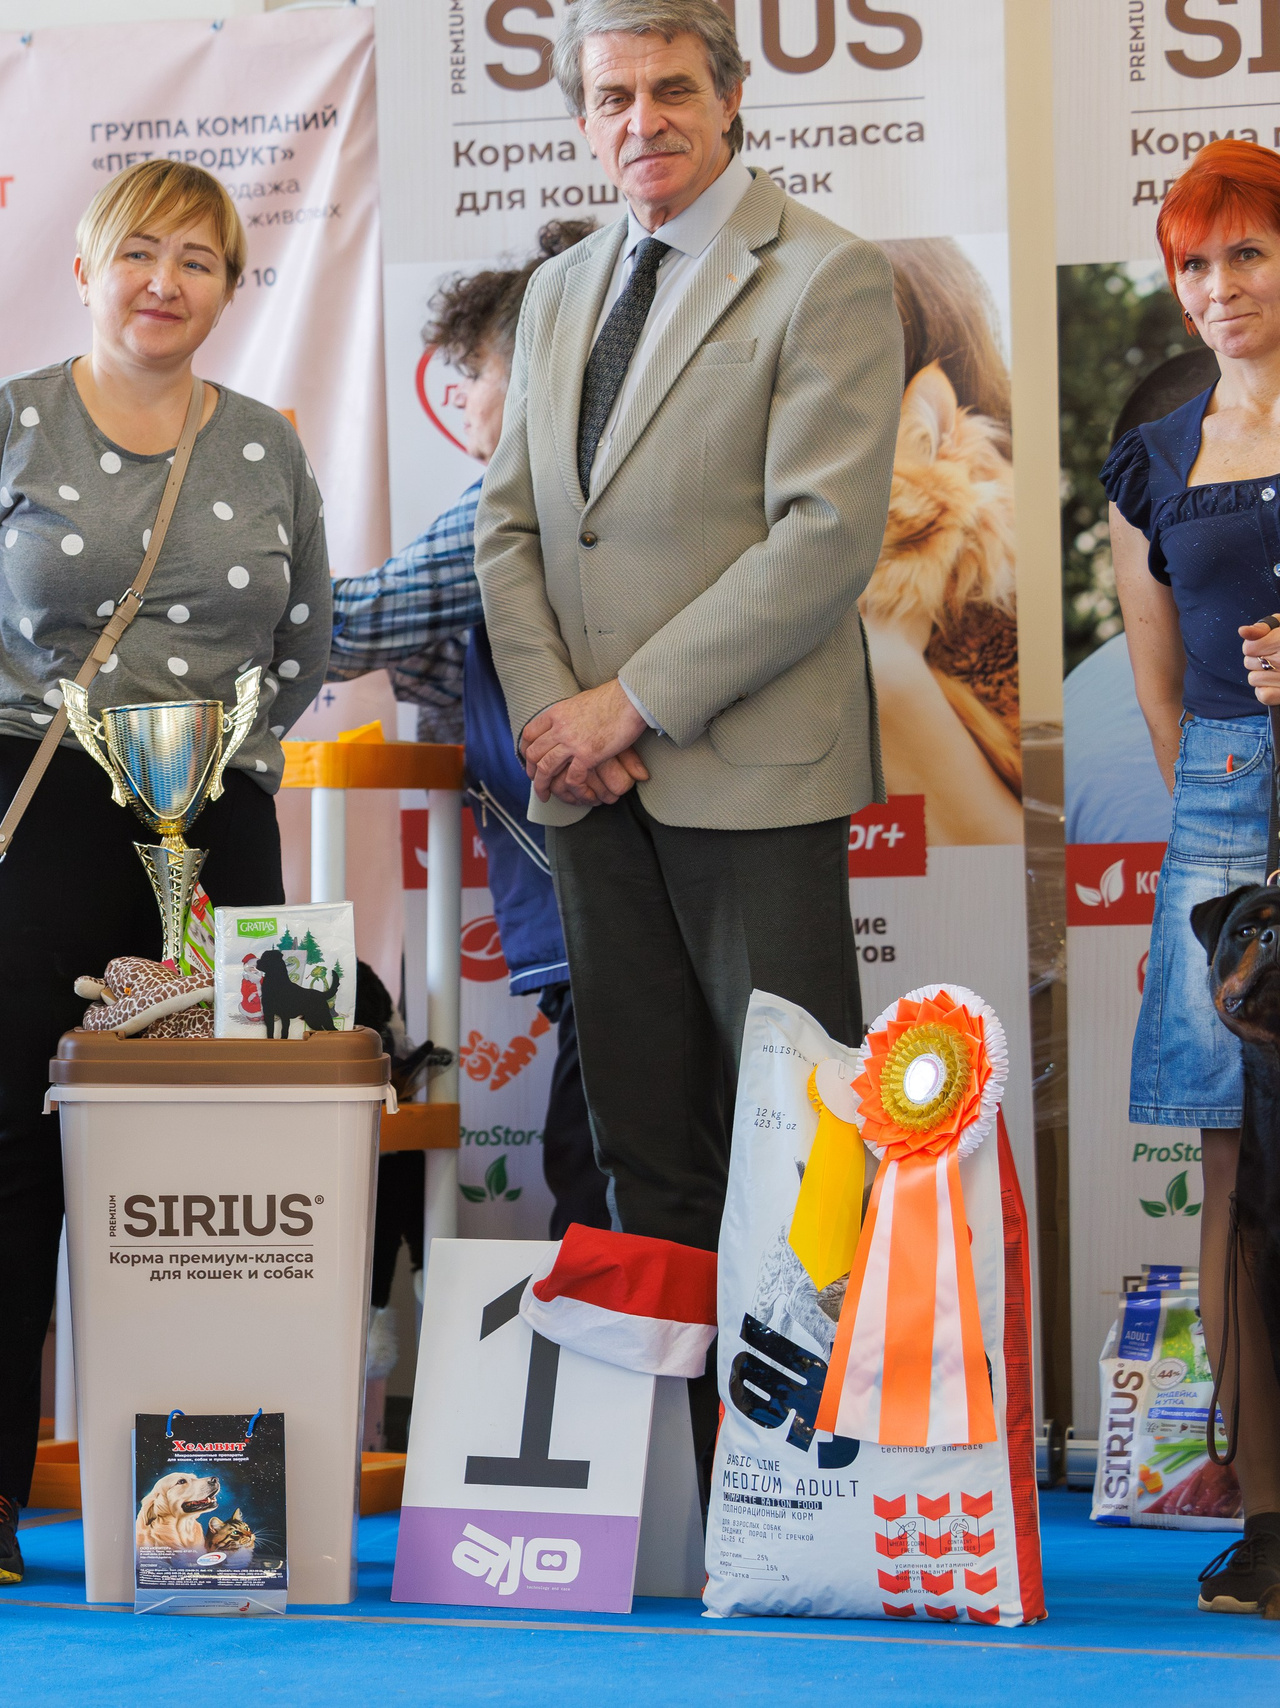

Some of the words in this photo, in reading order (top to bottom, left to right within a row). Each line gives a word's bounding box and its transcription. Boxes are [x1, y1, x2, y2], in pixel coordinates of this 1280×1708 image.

[484, 0, 924, 92] SUS
[1129, 0, 1145, 82] PREMIU
[91, 120, 189, 143] ГРУППА
[196, 104, 339, 138] КОМПАНИЙ
[453, 139, 577, 172] Корма
[745, 121, 925, 152] м-класса
[455, 189, 525, 216] для
[540, 185, 620, 207] кош
[769, 166, 833, 195] бак
[239, 921, 275, 933] GRATIAS
[756, 1107, 768, 1117] 12
[754, 1118, 781, 1130] 423.3
[786, 1123, 797, 1131] oz
[1132, 1142, 1202, 1163] ProSto
[108, 1194, 117, 1238] PREMIUM
[109, 1251, 164, 1267] Корма
[169, 1252, 314, 1267] премиум-класса
[150, 1269, 182, 1282] для
[187, 1269, 243, 1280] кошек
[248, 1269, 259, 1280] и
[263, 1266, 314, 1280] собак
[1125, 1330, 1151, 1342] ADULT
[464, 1274, 591, 1490] 1
[1157, 1369, 1181, 1380] 44%
[1156, 1389, 1198, 1399] ИНДЕЙКА
[1163, 1398, 1185, 1406] УТКА
[172, 1440, 246, 1452] Хелавит
[881, 1446, 935, 1456] technology
[962, 1443, 984, 1451] care
[726, 1454, 751, 1467] BASIC
[756, 1459, 780, 1472] LINE
[722, 1469, 782, 1495] MEDIUM
[796, 1479, 859, 1498] ADULT
[723, 1491, 758, 1504] COMPLETE
[761, 1497, 792, 1508] RATION
[797, 1500, 820, 1510] FOOD
[722, 1503, 787, 1519] ПОЛНОРАЦИОННЫЙ
[791, 1511, 814, 1521] КОРМ
[733, 1519, 760, 1530] ВЗРОСЛЫХ
[763, 1523, 782, 1532] СОБАК
[721, 1534, 736, 1543] 11-25
[722, 1526, 742, 1535] СРЕДНИХ
[749, 1530, 767, 1539] ПОРОД
[786, 1534, 815, 1542] ГРЕЧКОЙ
[720, 1550, 742, 1558] протеин
[757, 1554, 769, 1562] 25%
[720, 1560, 732, 1568] жиры
[766, 1564, 778, 1572] 15%
[720, 1569, 750, 1579] клетчатка
